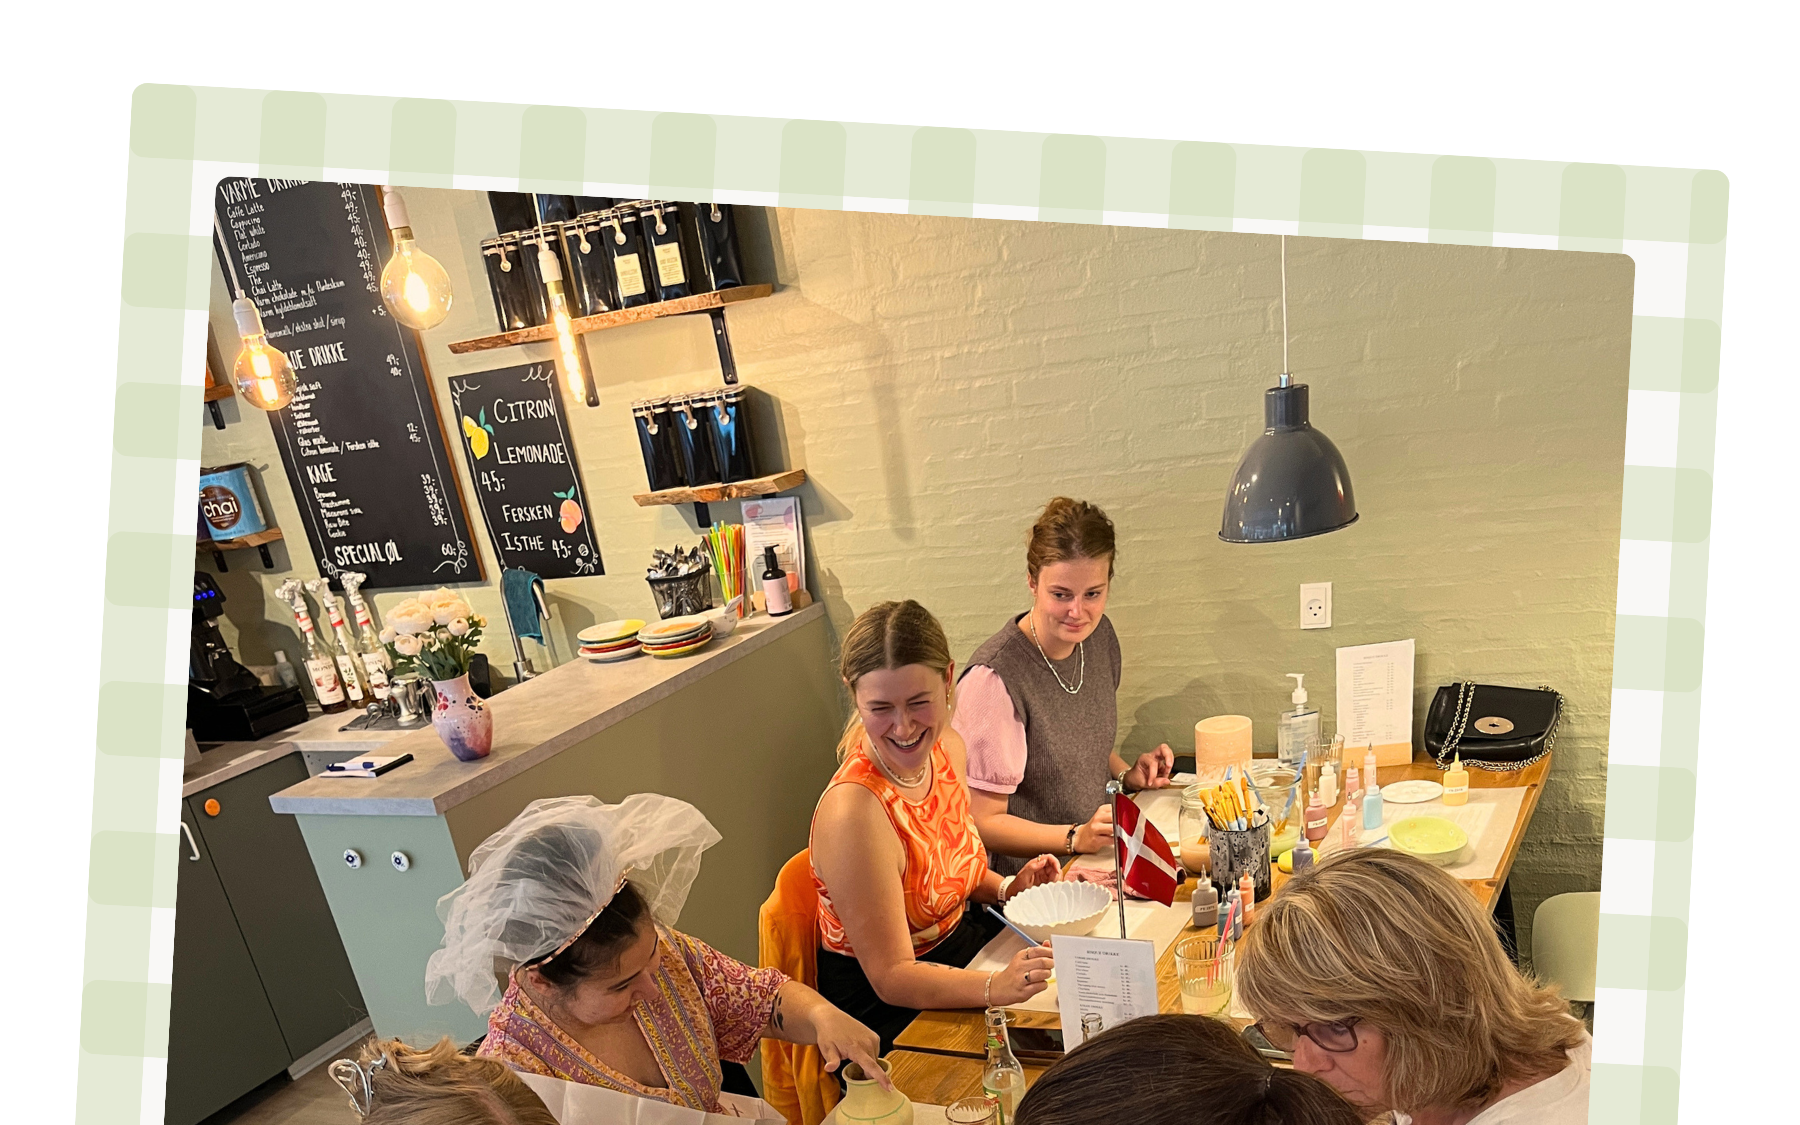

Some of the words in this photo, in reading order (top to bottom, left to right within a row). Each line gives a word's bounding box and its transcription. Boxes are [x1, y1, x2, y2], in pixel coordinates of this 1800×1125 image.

[220, 177, 261, 204] VARME
[245, 202, 264, 215] Latte
[248, 274, 262, 285] The
[252, 286, 266, 296] Chai
[267, 280, 283, 292] Latte
[308, 342, 348, 367] DRIKKE
[493, 398, 554, 423] CITRON
[494, 442, 566, 465] LEMONADE
[306, 462, 337, 484] KAGE
[203, 497, 238, 518] chai
[502, 504, 553, 523] FERSKEN
[501, 532, 545, 551] ISTHE
